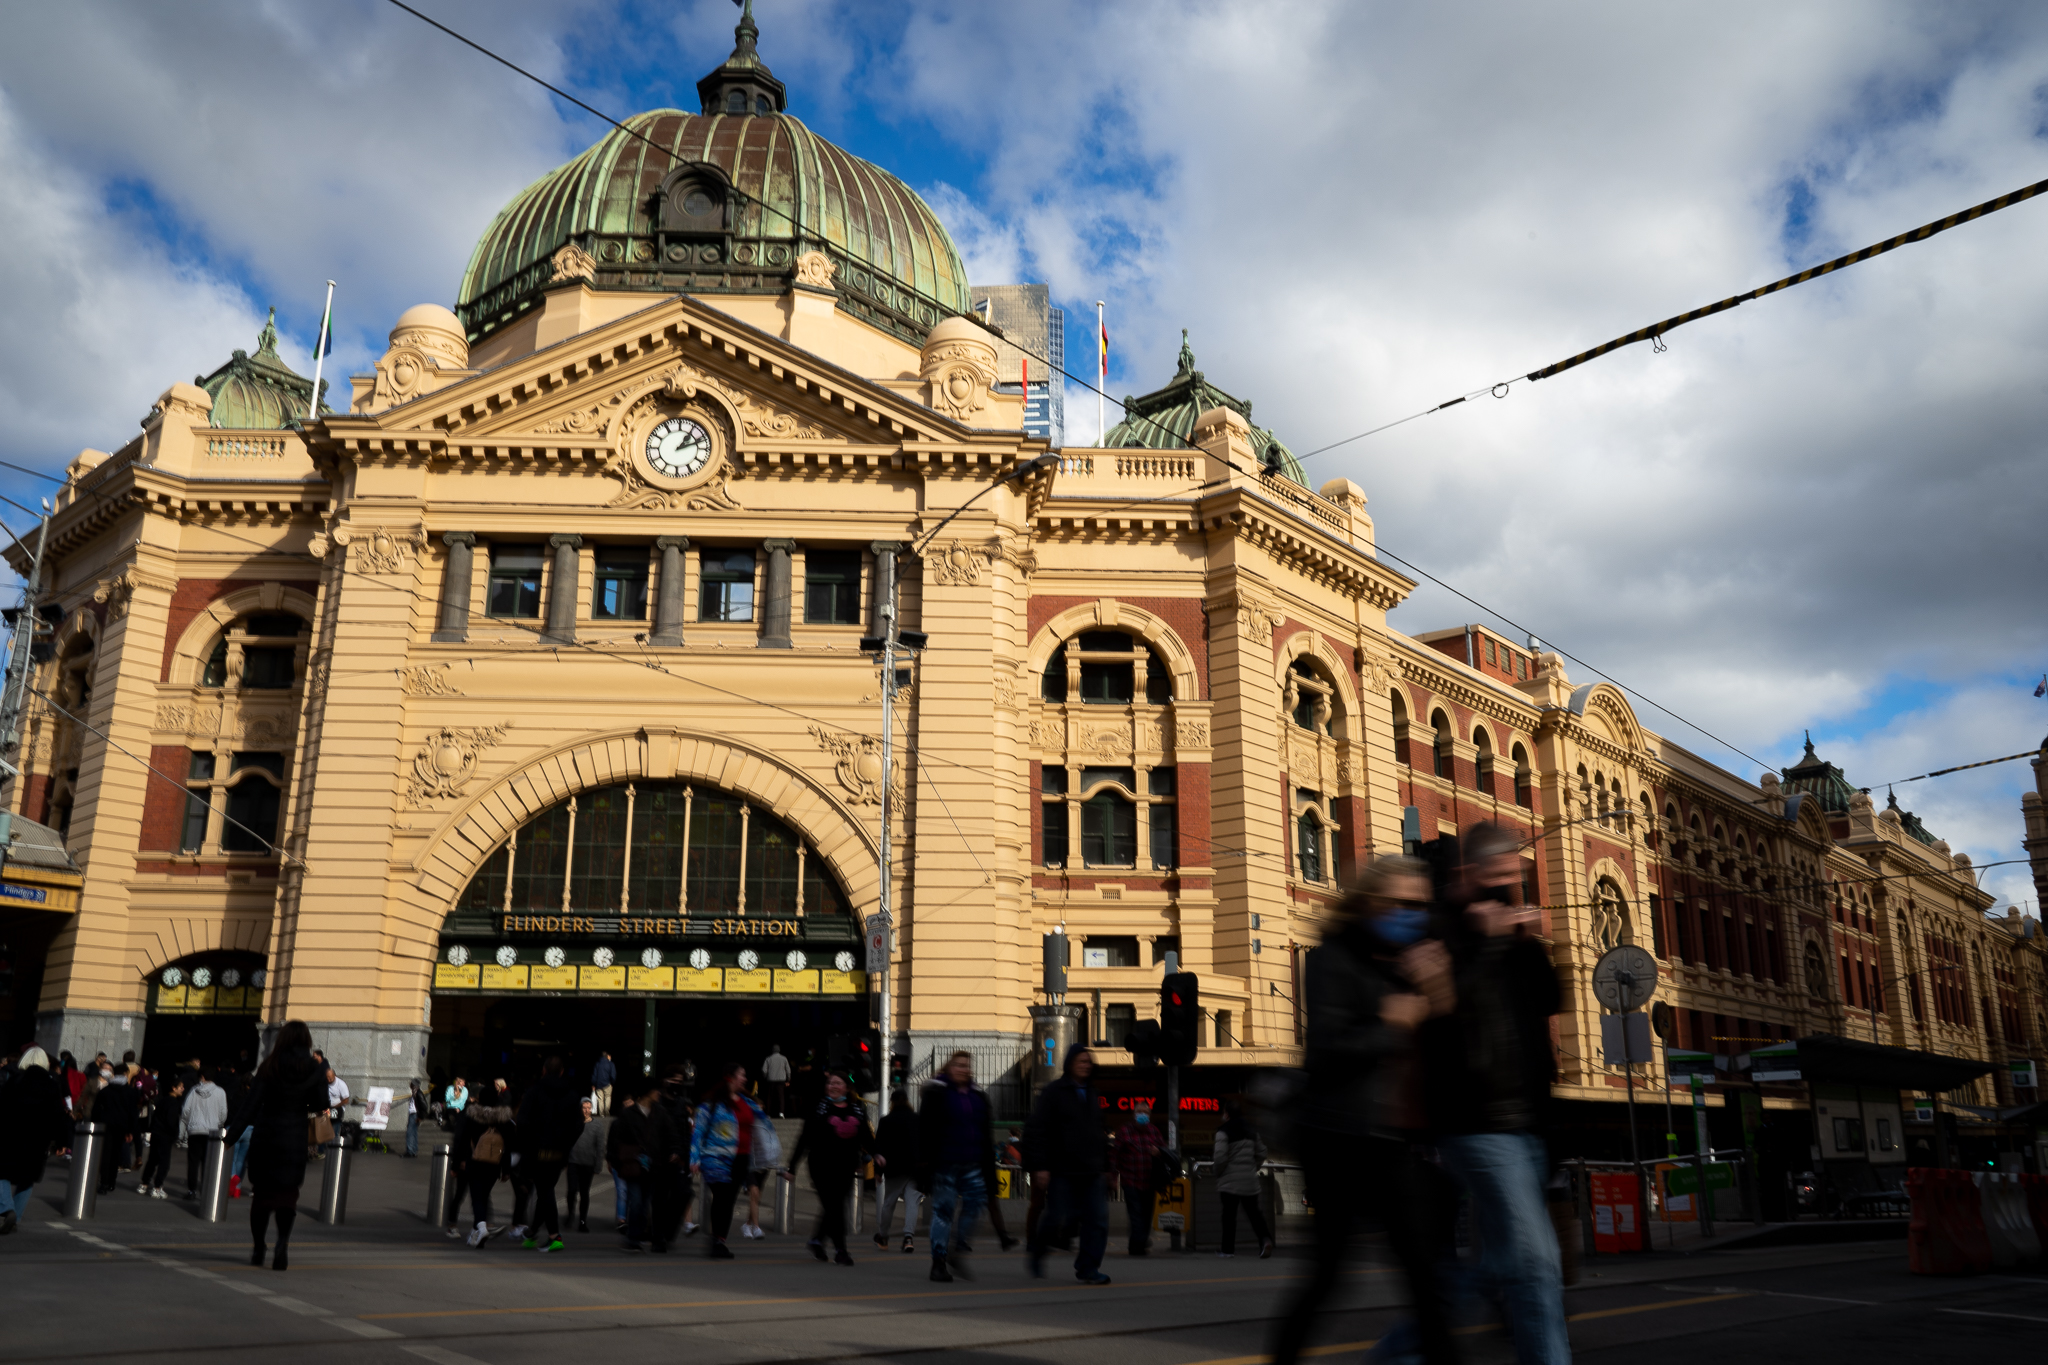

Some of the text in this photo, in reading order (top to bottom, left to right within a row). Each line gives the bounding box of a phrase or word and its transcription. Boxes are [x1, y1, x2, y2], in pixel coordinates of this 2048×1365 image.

[4, 884, 34, 899] Flinders
[502, 915, 799, 937] FLINDERS STREET STATION
[1117, 1096, 1220, 1112] CITY ATTERS
